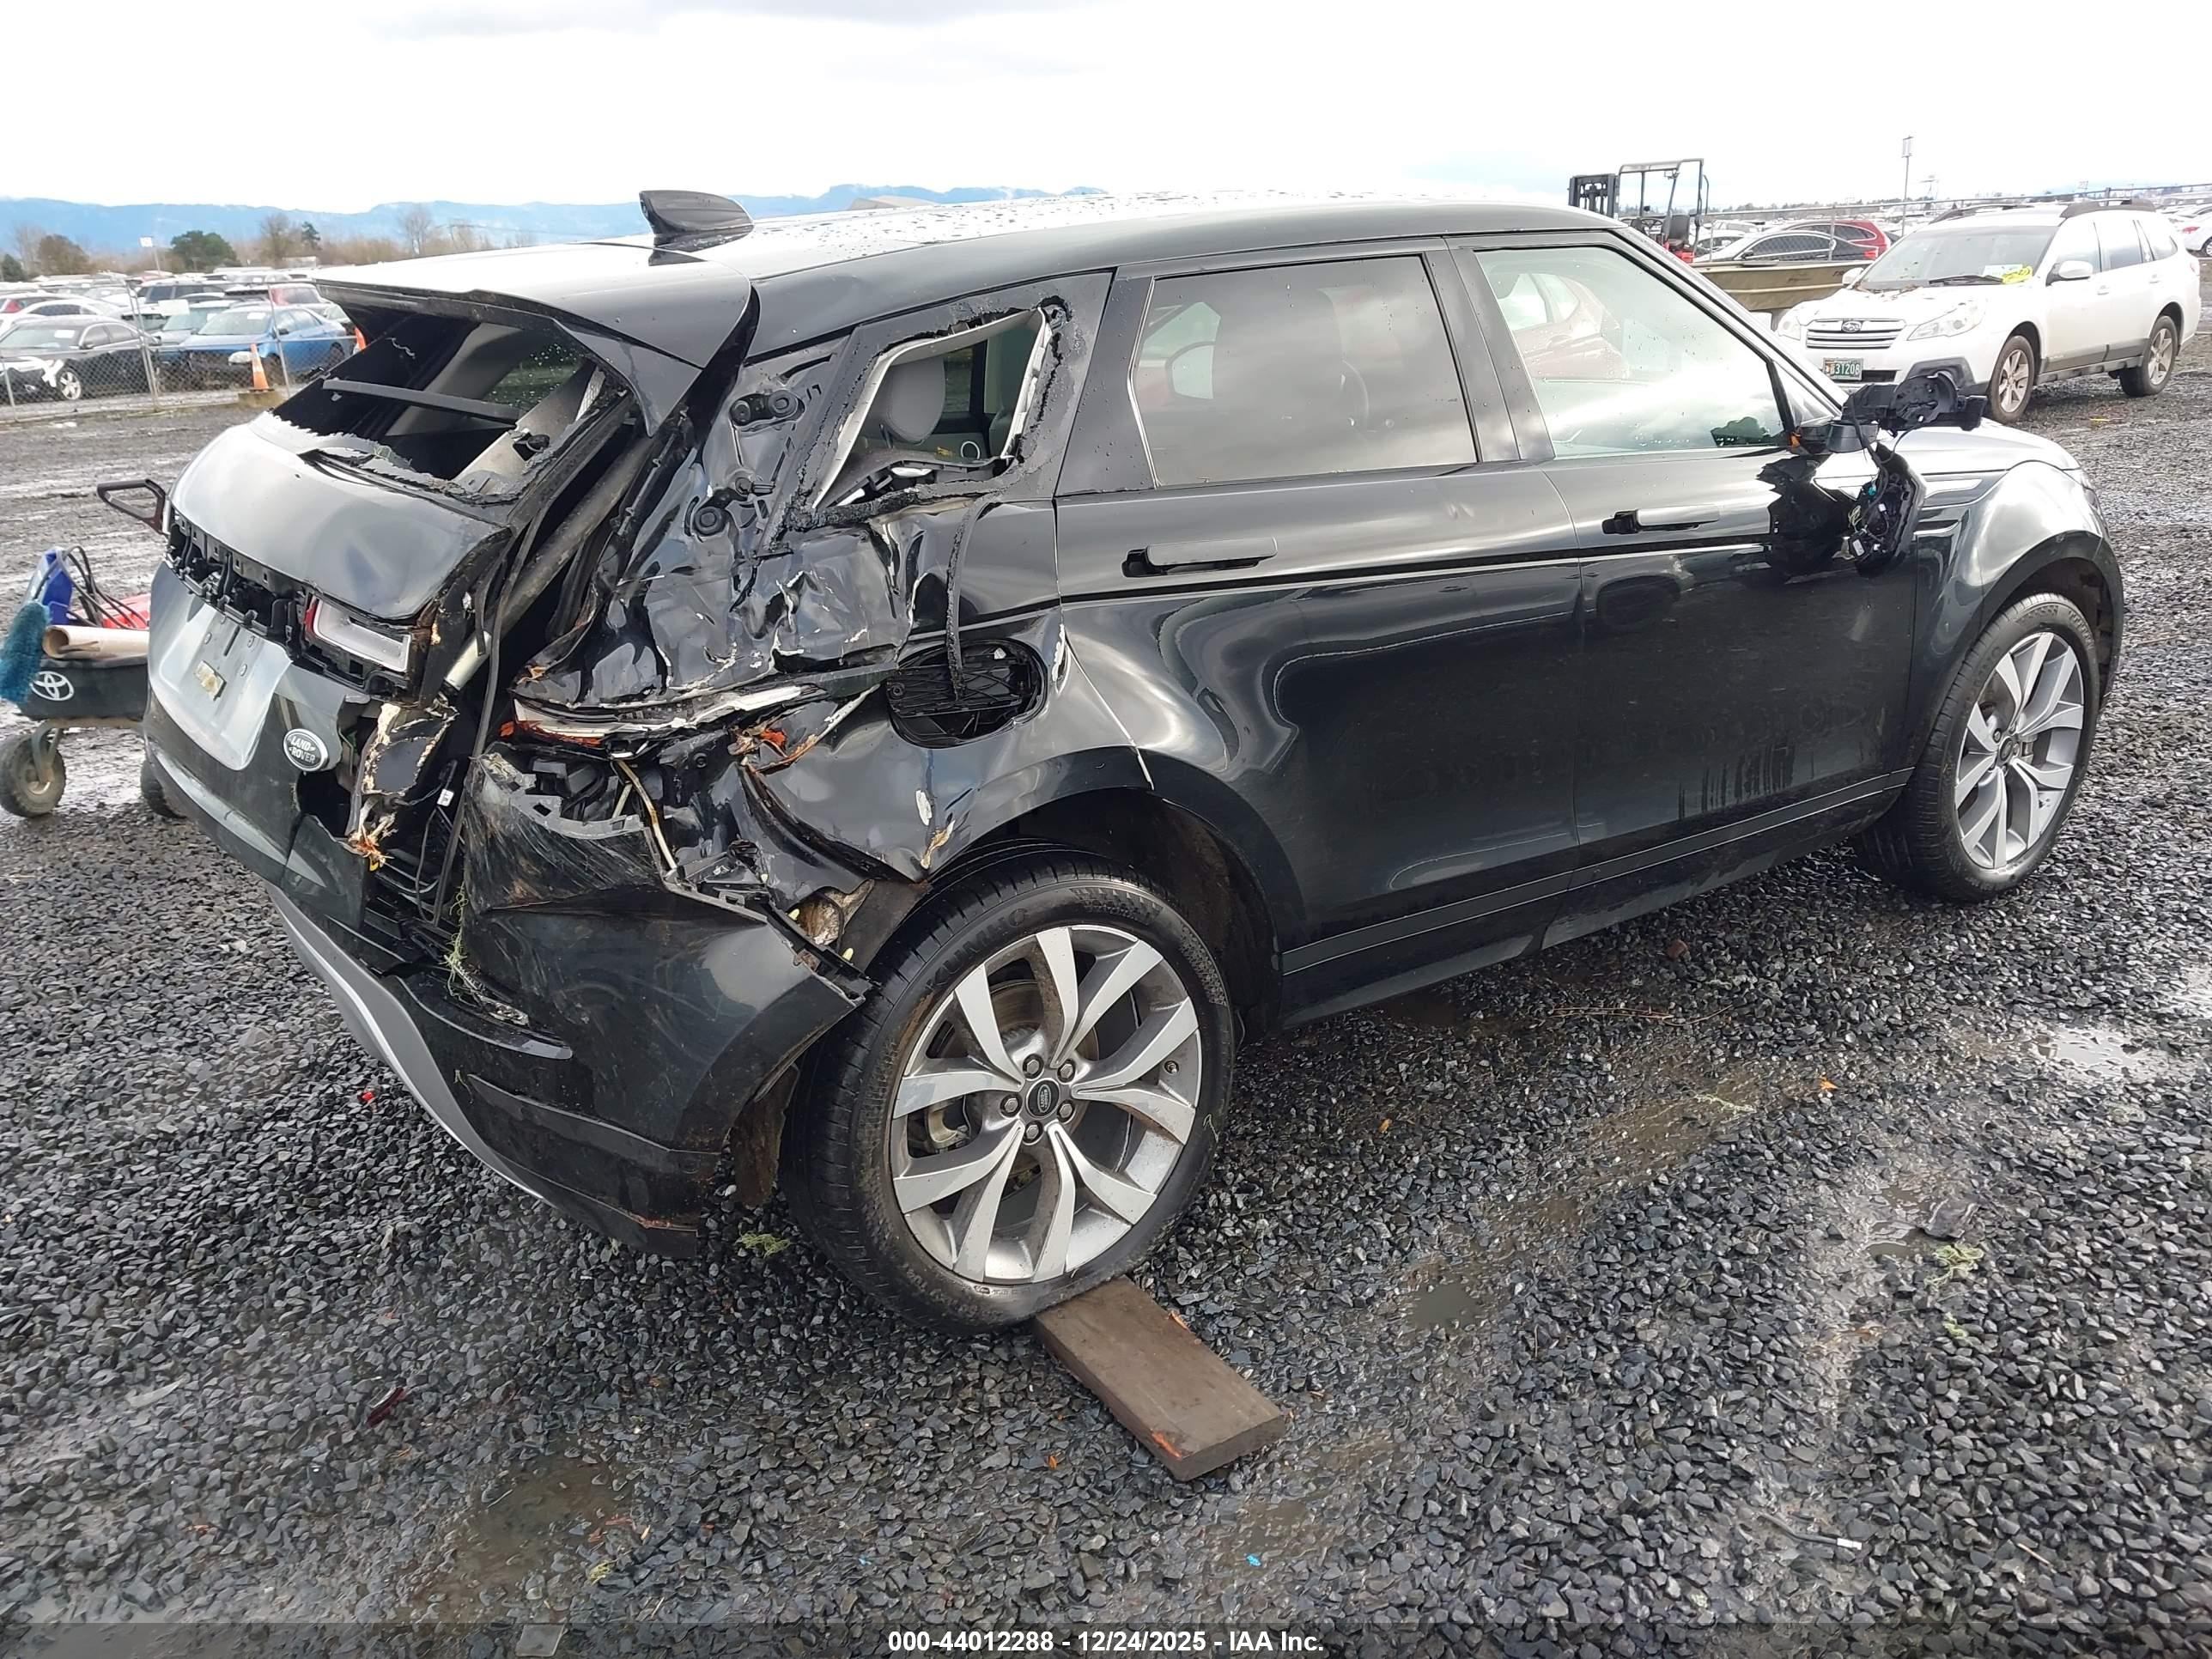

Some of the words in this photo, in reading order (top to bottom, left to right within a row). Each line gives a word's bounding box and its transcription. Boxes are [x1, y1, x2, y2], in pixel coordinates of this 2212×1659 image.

[290, 735, 313, 751] LAND
[291, 746, 315, 763] ROVER
[925, 907, 1028, 988] KUMHO
